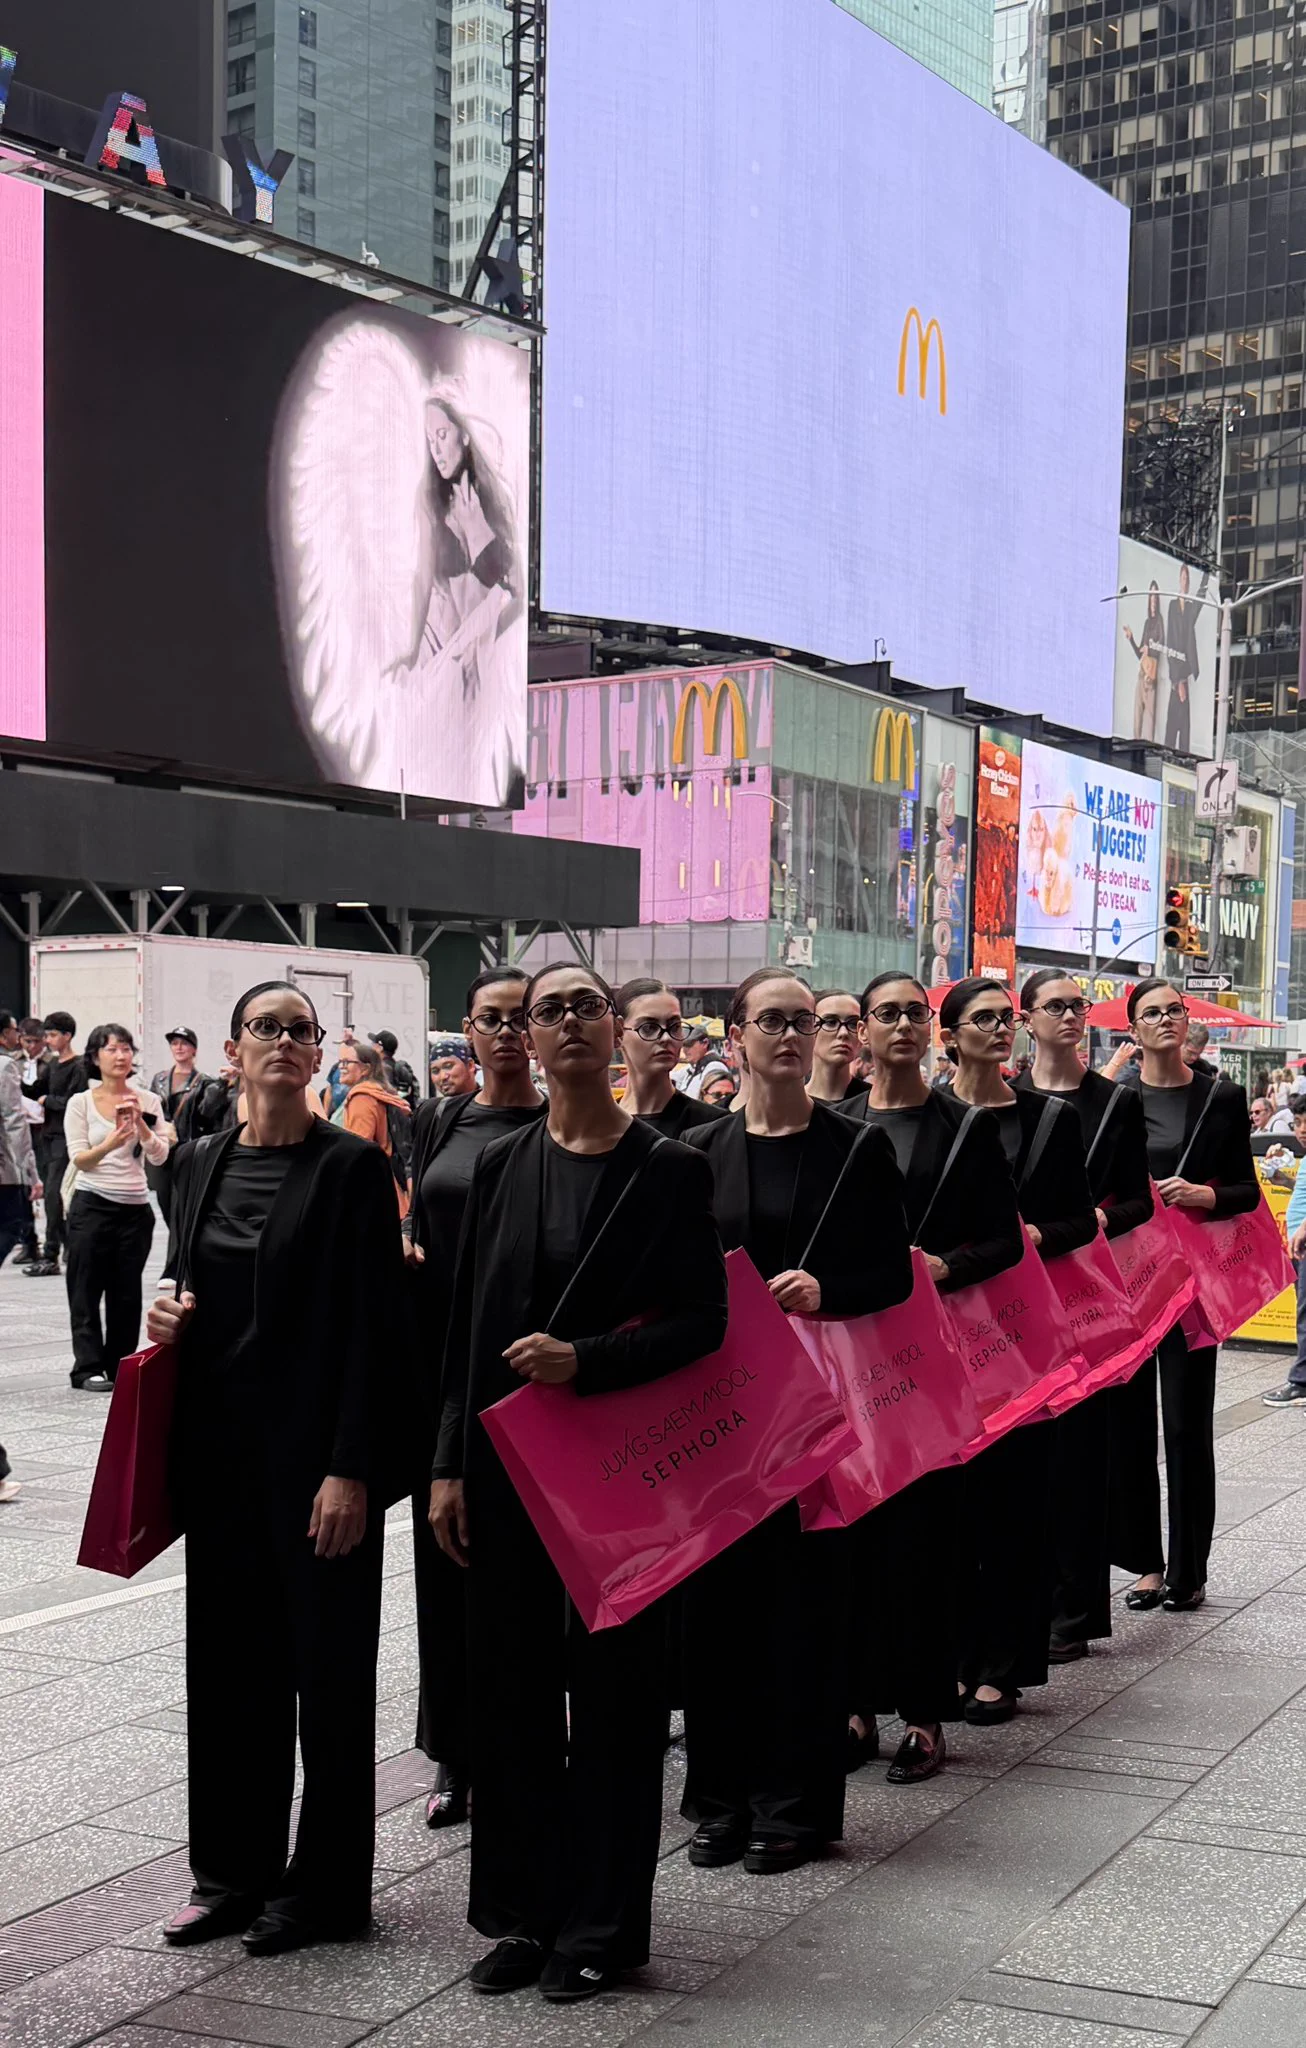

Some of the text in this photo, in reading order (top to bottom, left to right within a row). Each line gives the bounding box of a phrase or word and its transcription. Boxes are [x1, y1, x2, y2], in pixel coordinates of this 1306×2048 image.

[0, 45, 295, 224] AY
[1084, 782, 1157, 831] WE ARE NOT
[1202, 800, 1229, 812] ONLY
[1092, 822, 1147, 864] NUGGETS!
[1097, 890, 1137, 912] GO VEGAN.
[1129, 874, 1140, 890] eat
[1233, 882, 1242, 893] W
[1245, 881, 1256, 893] 45
[1219, 897, 1260, 941] NAVY
[1192, 980, 1225, 988] ONE WAY
[1217, 1243, 1255, 1275] SEPHORA
[1126, 1260, 1159, 1299] EPHORA
[1069, 1306, 1103, 1330] PHORA
[890, 1341, 925, 1375] MOOL
[968, 1328, 1024, 1373] SEPHORA
[701, 1364, 758, 1414] MOOL
[858, 1375, 919, 1422] SEPHORA
[641, 1408, 747, 1489] SEPHORA
